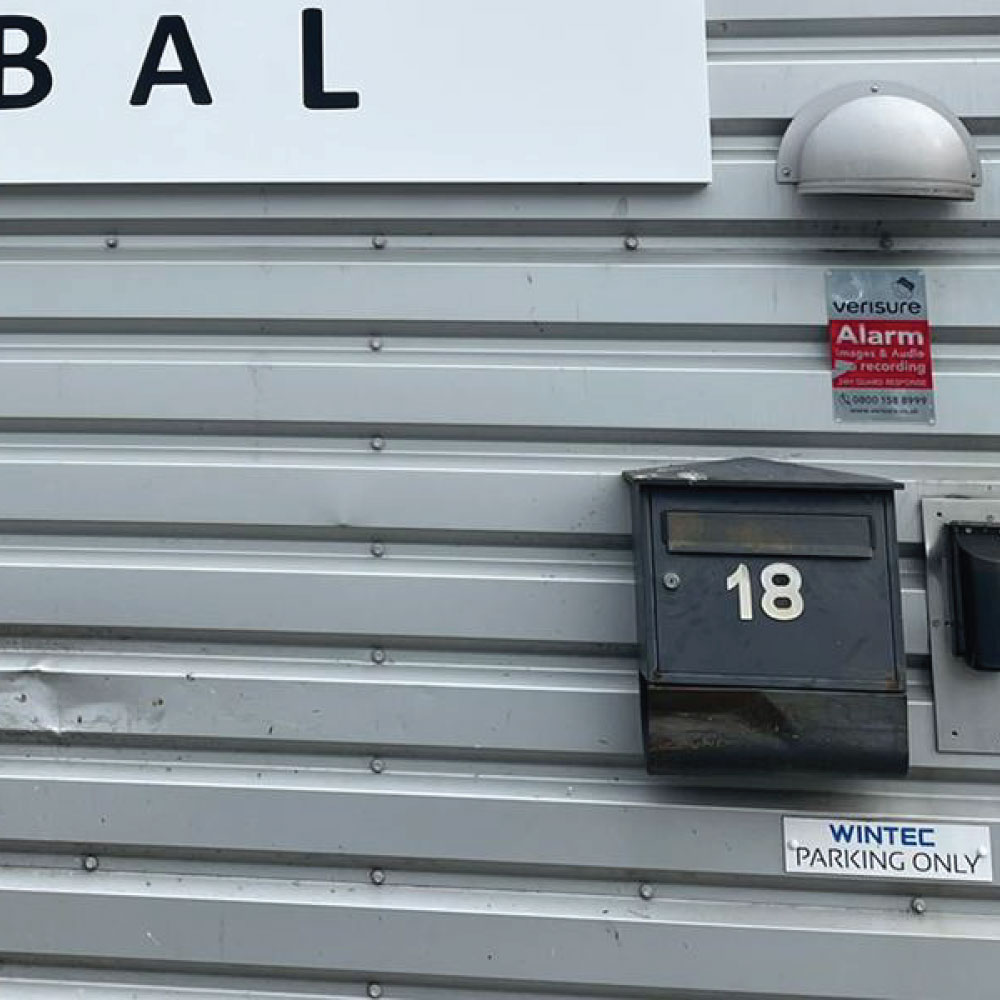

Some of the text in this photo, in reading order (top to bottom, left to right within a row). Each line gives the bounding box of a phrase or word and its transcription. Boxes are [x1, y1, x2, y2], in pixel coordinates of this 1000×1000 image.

[833, 300, 922, 314] verisure
[836, 324, 925, 346] Alarm
[835, 347, 925, 360] Images & Audio
[860, 360, 926, 375] recording
[726, 562, 804, 621] 18
[829, 823, 936, 848] WINTEC
[796, 847, 981, 875] PARKING ONLY
